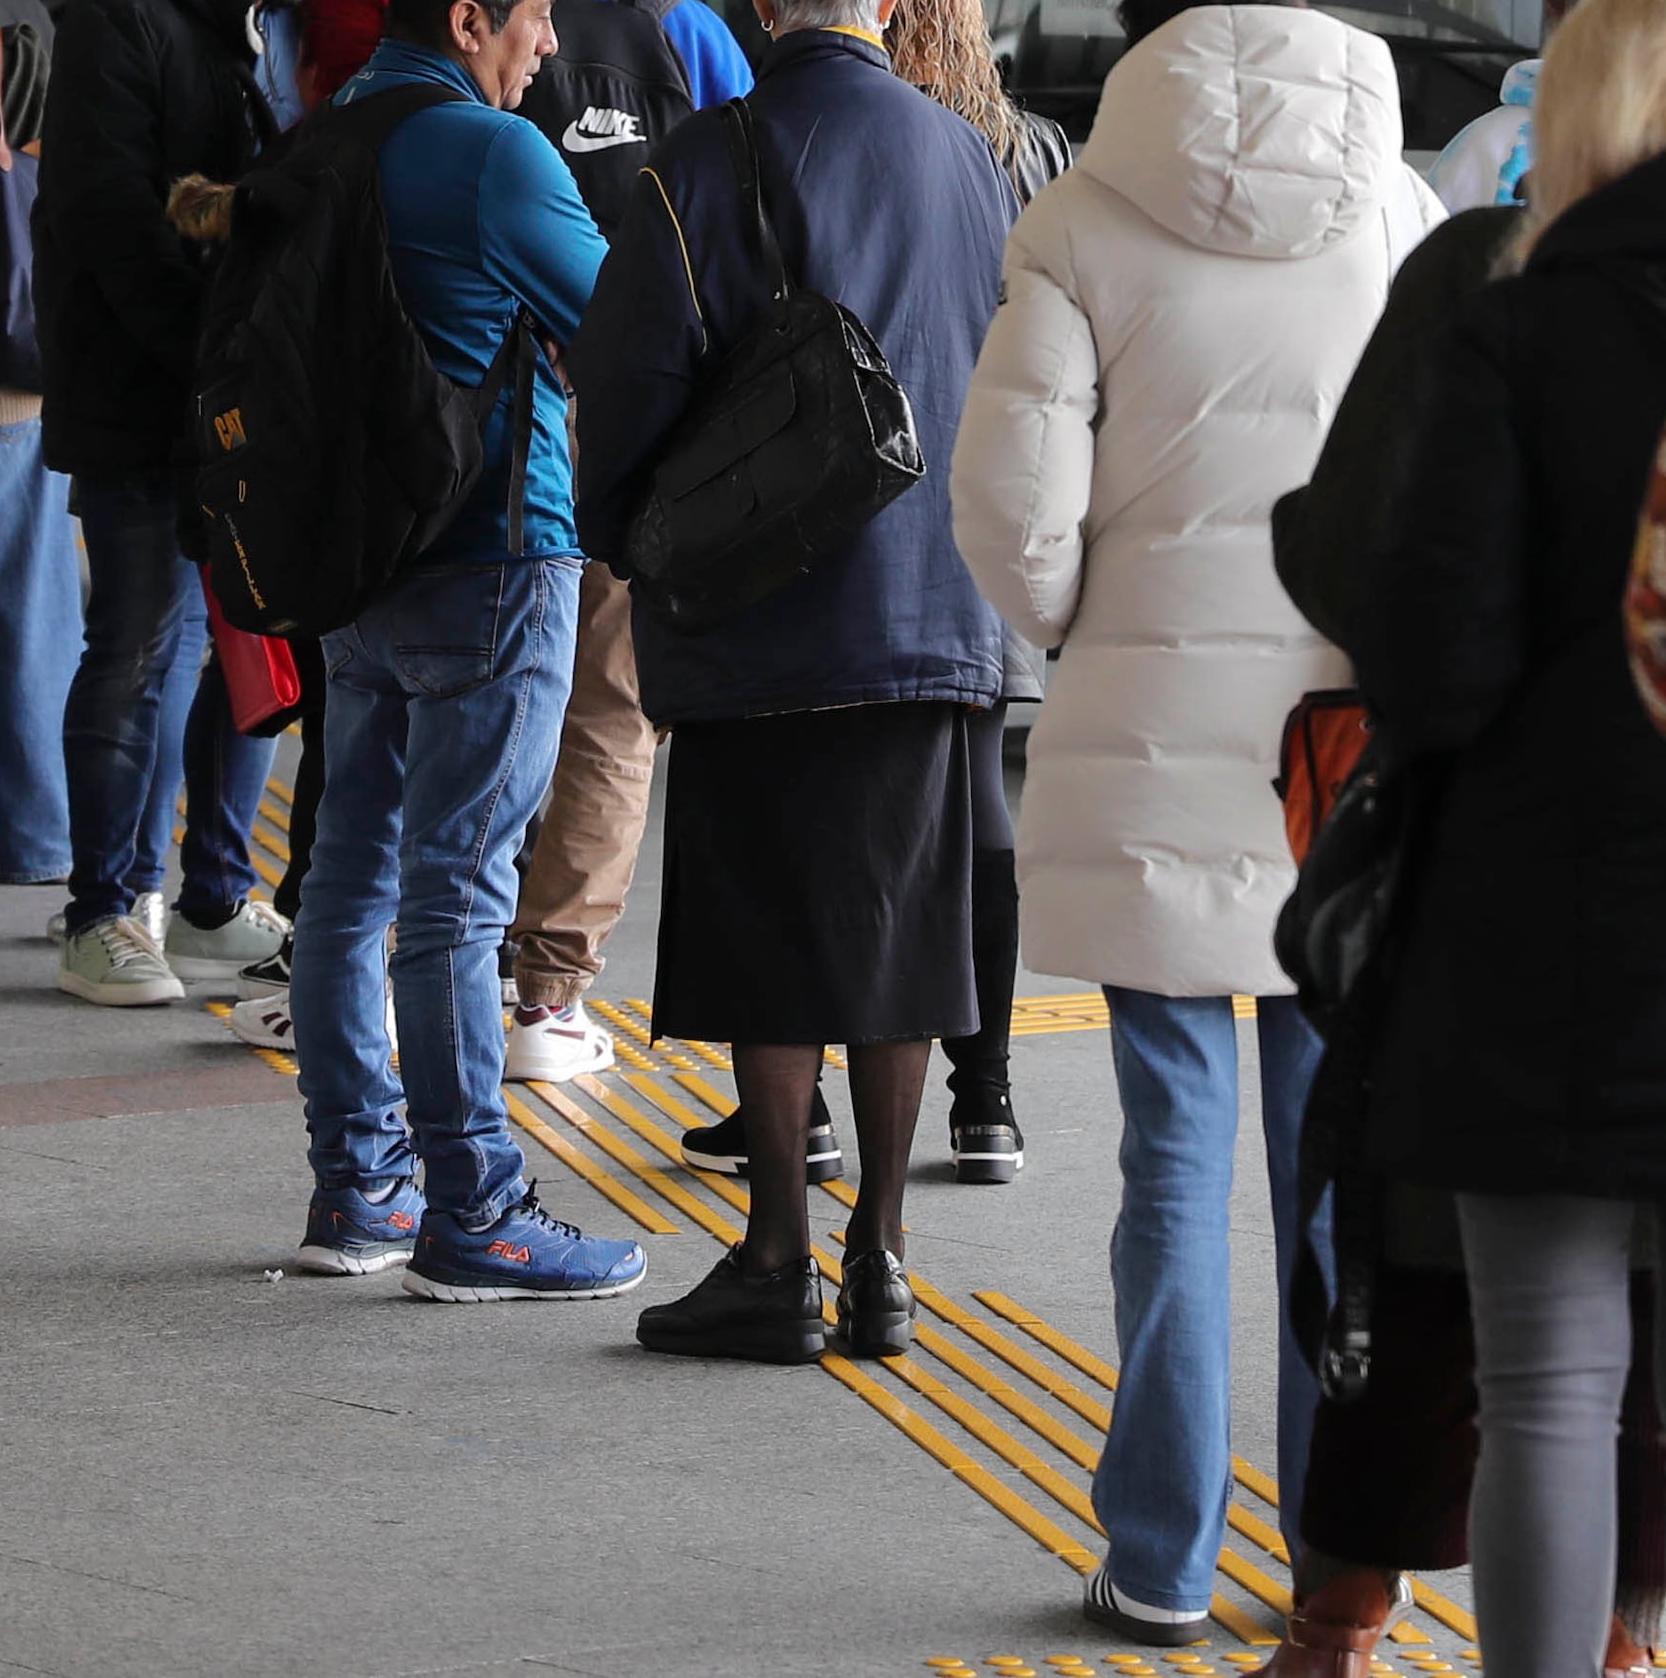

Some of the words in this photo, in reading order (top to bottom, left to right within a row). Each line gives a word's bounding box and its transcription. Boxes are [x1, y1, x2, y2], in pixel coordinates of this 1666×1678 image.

[578, 106, 642, 138] NIKE
[214, 408, 247, 451] CAT
[386, 1210, 415, 1231] FILA
[486, 1240, 531, 1264] FILA
